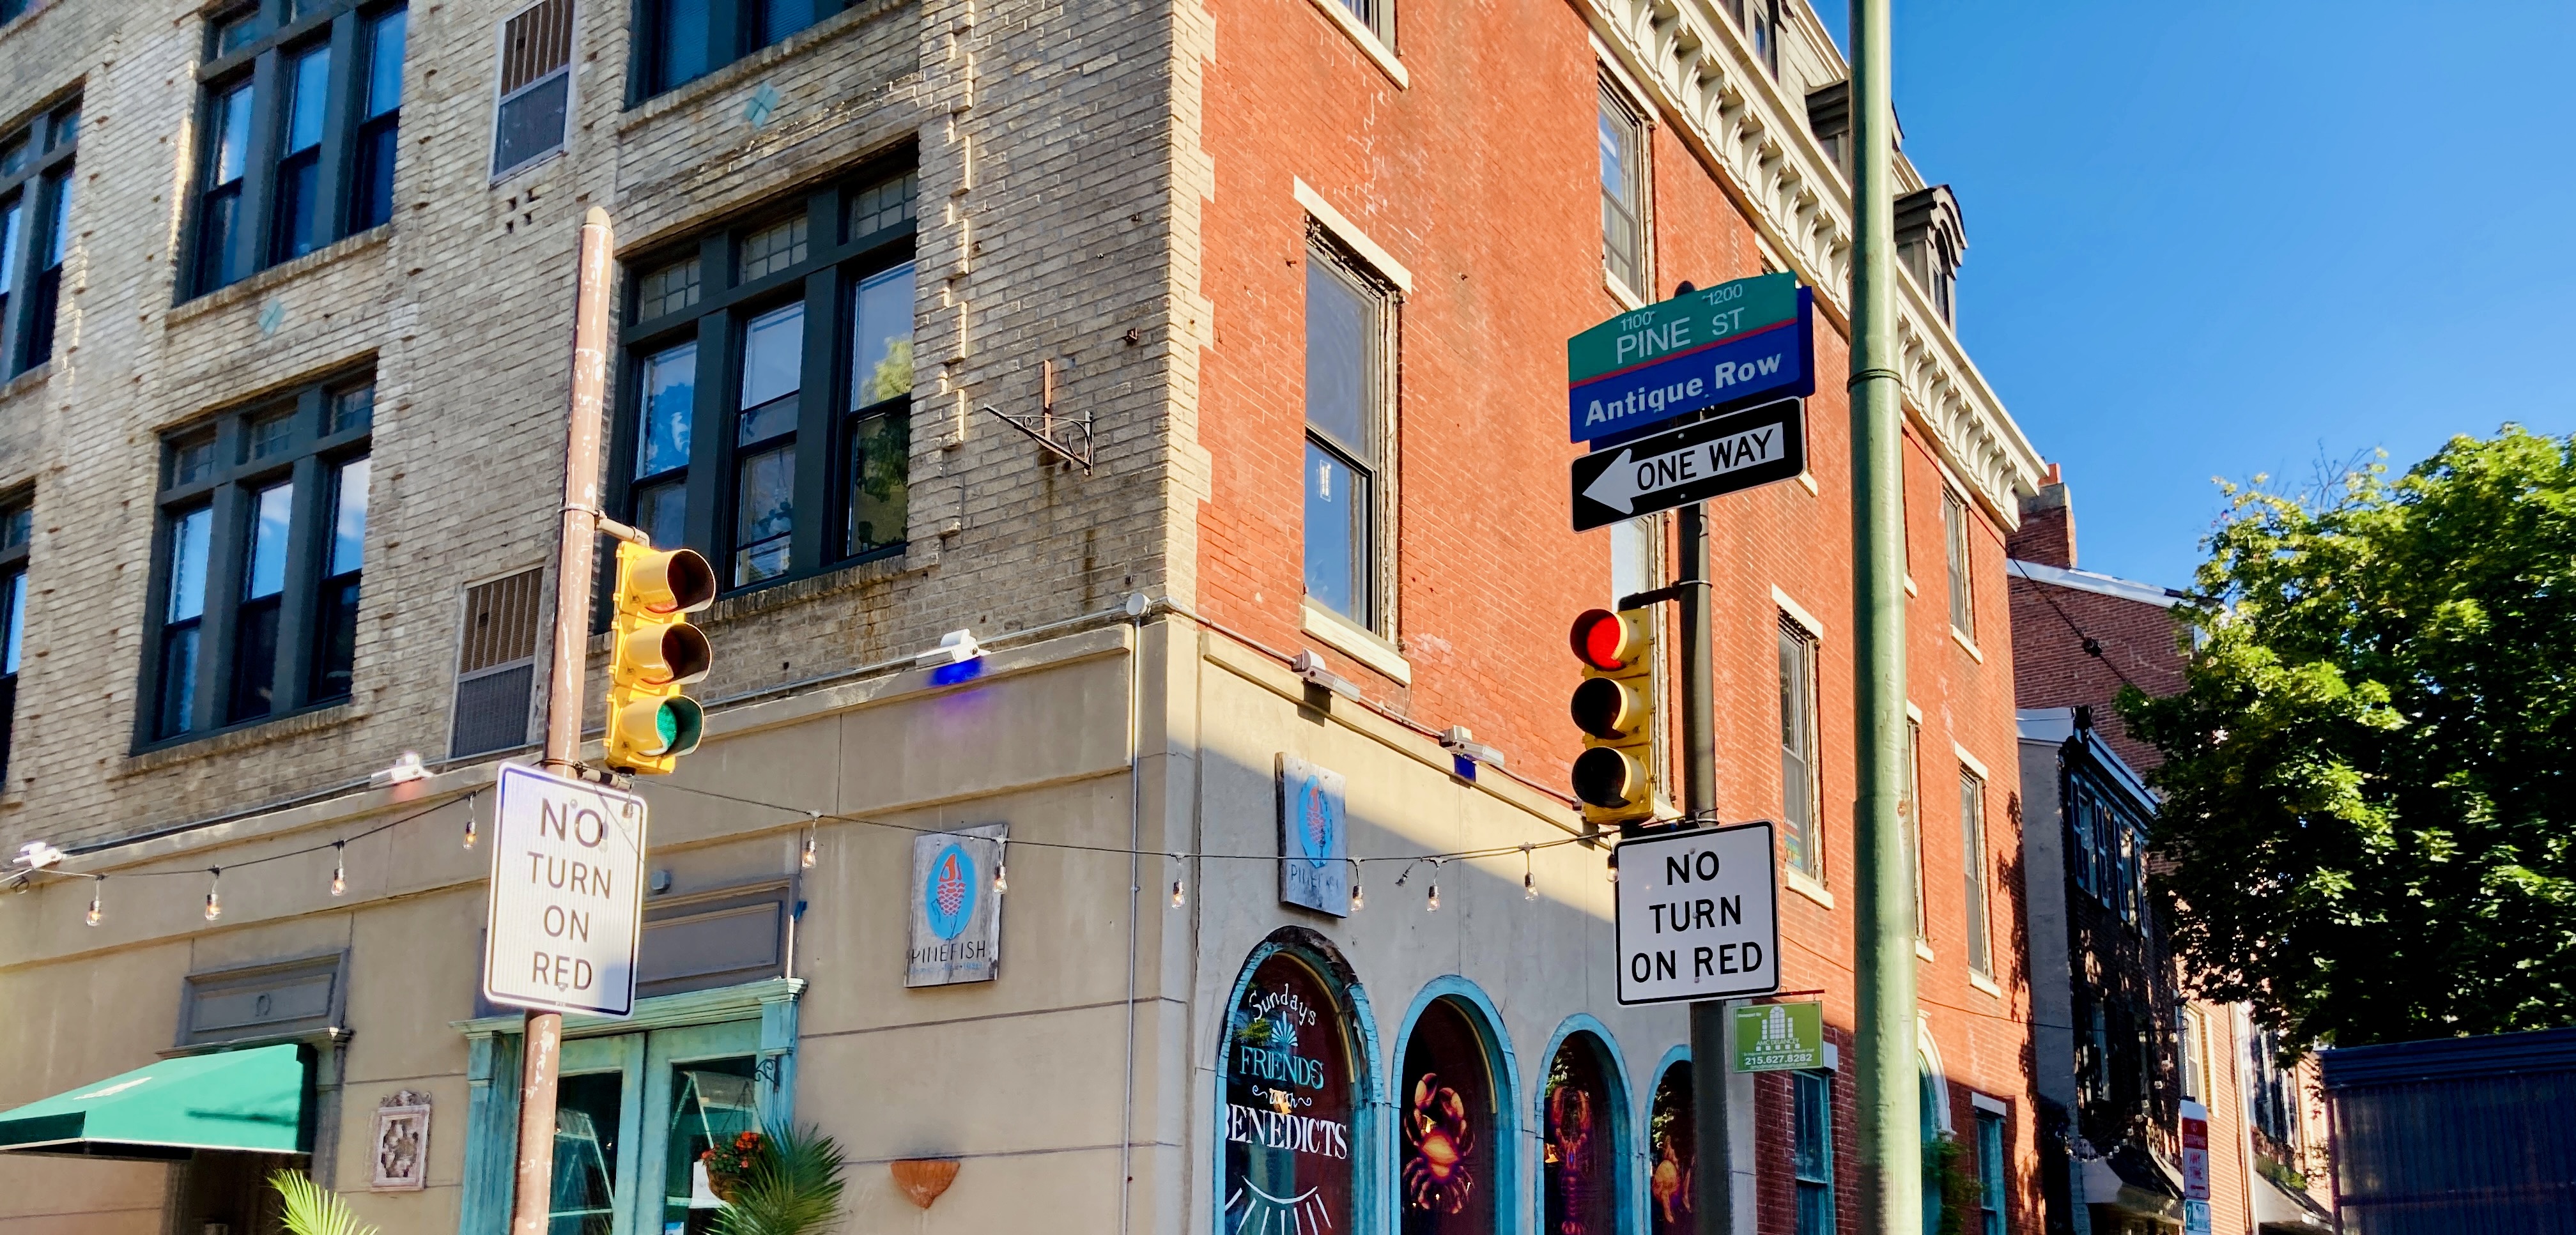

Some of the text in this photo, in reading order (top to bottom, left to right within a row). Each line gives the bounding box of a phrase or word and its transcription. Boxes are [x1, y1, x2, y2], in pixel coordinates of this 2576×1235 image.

[1620, 283, 1743, 332] 1100 1200
[1617, 307, 1745, 364] PINE ST
[1585, 353, 1782, 427] Antique Row
[1637, 428, 1774, 491] ONE WAY
[540, 797, 604, 848] NO
[527, 850, 612, 900] TURN
[1667, 850, 1720, 886] NO
[543, 905, 589, 943] ON
[1649, 894, 1741, 934] TURN
[532, 951, 592, 991] RED
[1631, 941, 1762, 983] ON RED
[1248, 983, 1316, 1027] Sundays
[1240, 1045, 1325, 1090] FRIENDS
[1745, 1053, 1812, 1065] 215.627.8282
